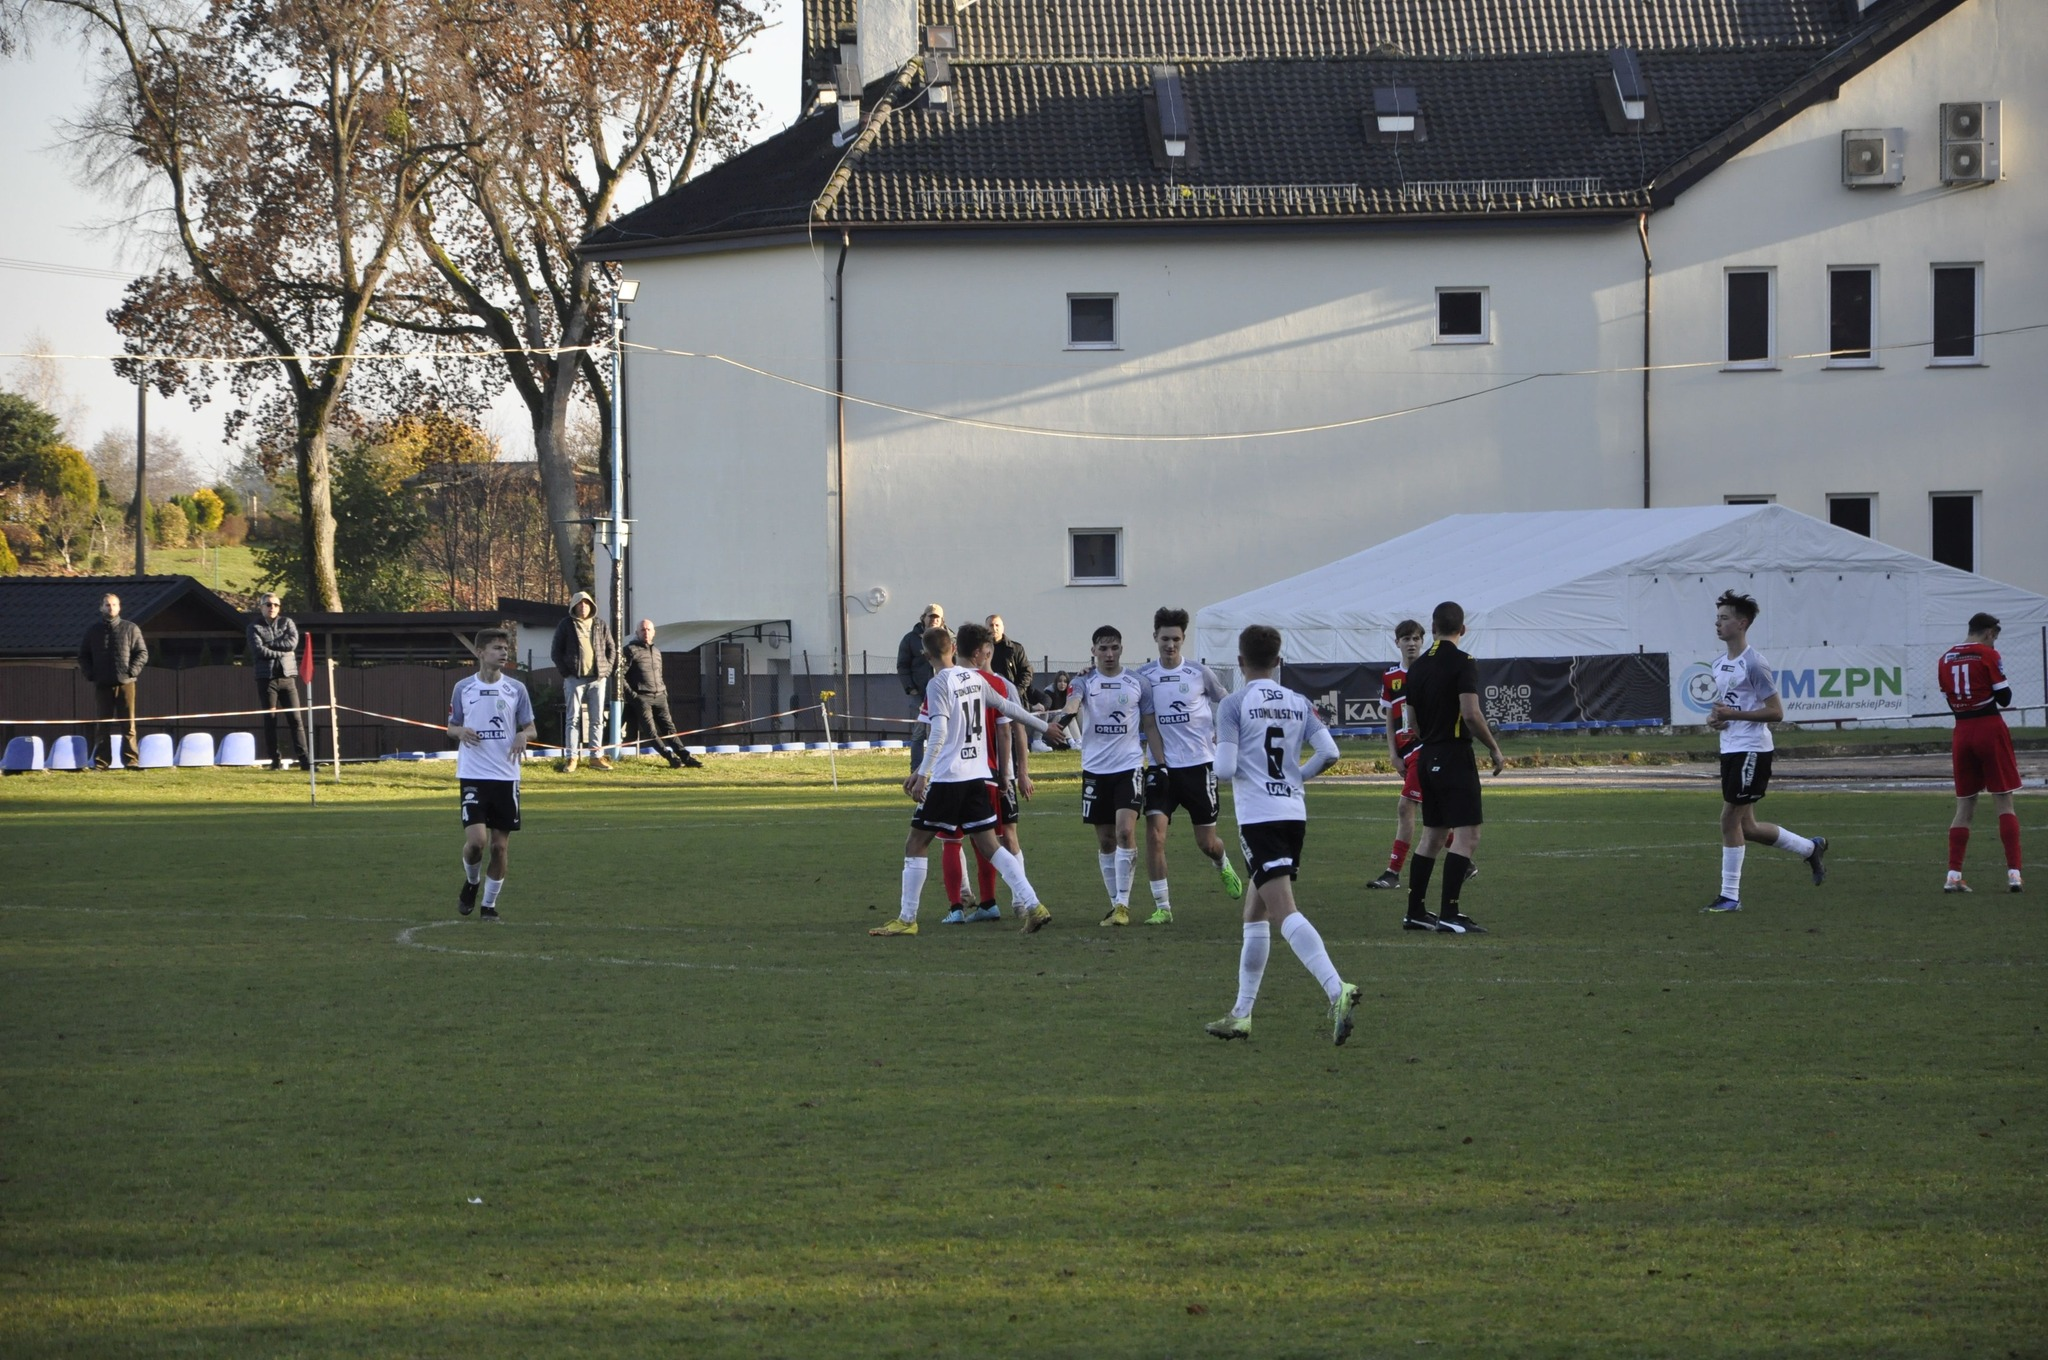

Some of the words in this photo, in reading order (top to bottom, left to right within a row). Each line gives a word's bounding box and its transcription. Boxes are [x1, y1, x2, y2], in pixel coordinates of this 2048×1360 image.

[1771, 667, 1902, 698] MZPN
[1951, 664, 1972, 698] 11
[1258, 688, 1284, 703] TSG
[1787, 699, 1902, 711] #KrainaPiłkarskiejPasji
[962, 698, 982, 743] 14
[1160, 714, 1189, 724] ORLEN
[478, 730, 506, 739] ORLEN
[1096, 725, 1126, 734] ORLEN
[1264, 726, 1285, 779] 6
[462, 805, 469, 822] 4
[1083, 800, 1092, 818] 17
